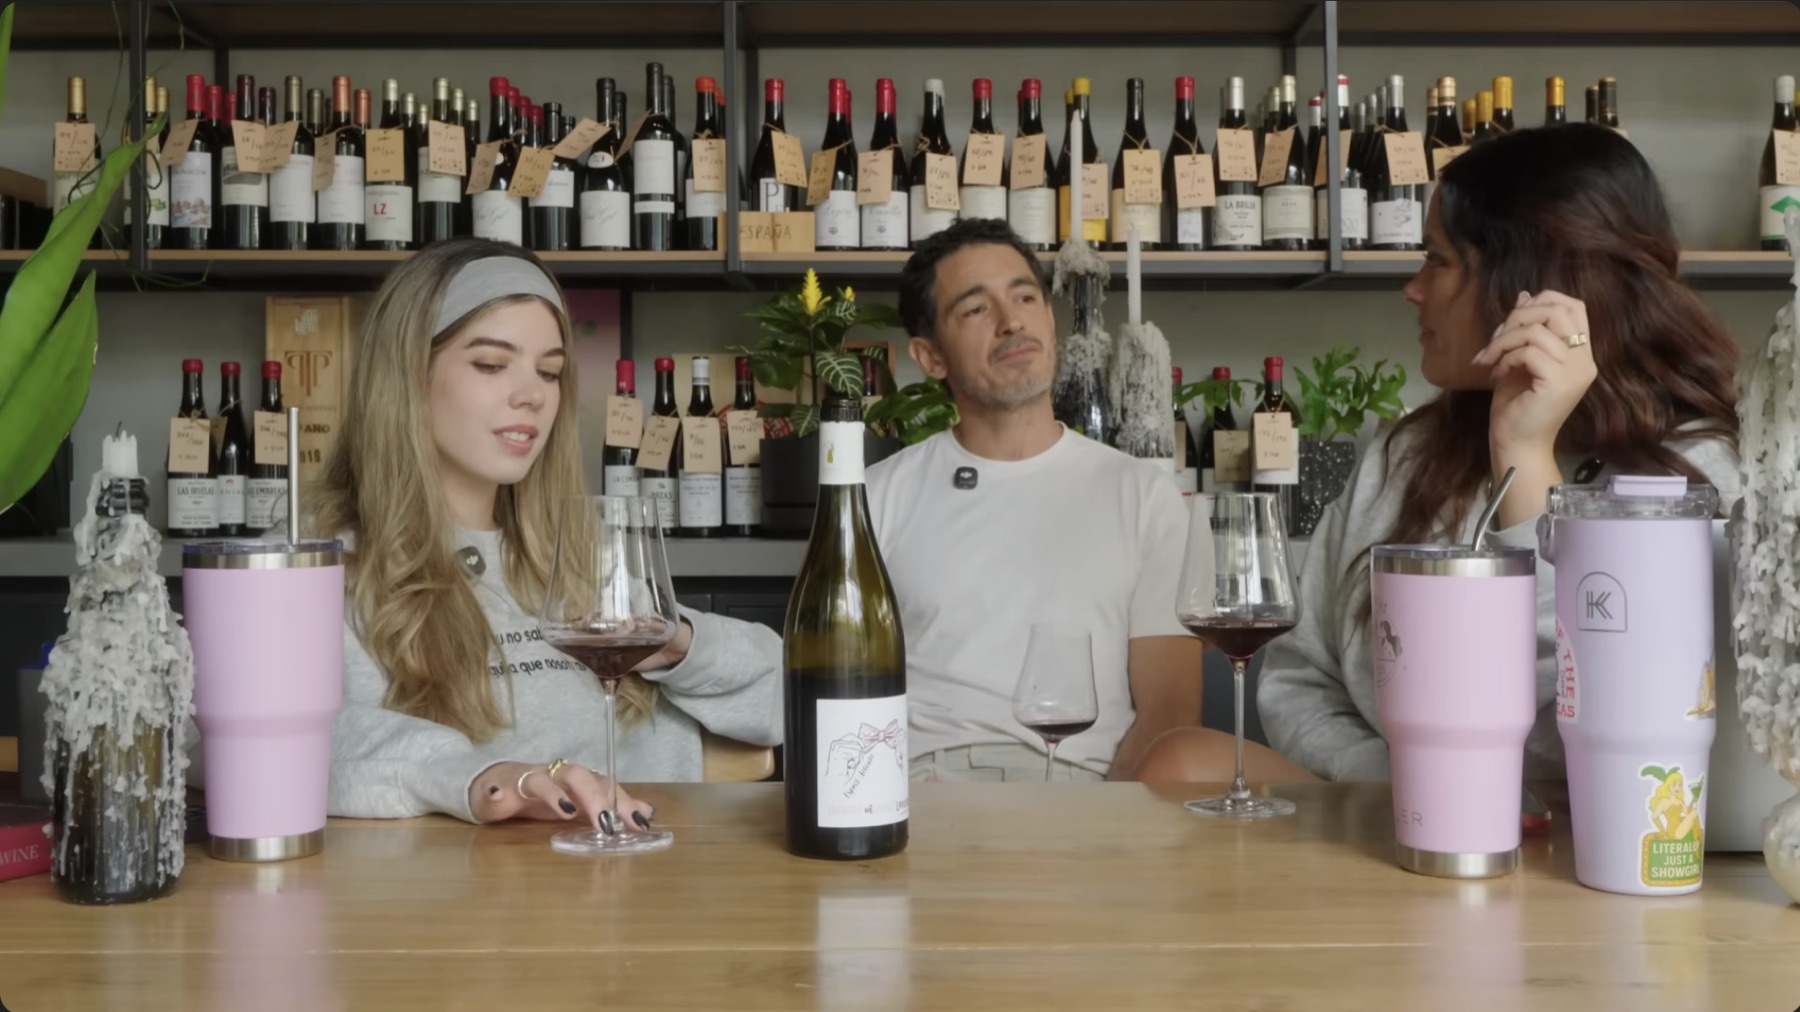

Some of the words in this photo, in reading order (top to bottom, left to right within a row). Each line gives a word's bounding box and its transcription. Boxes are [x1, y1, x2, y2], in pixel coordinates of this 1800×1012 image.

[373, 202, 388, 216] LZ
[739, 223, 792, 241] ESPAÑA
[506, 631, 522, 645] no
[524, 625, 545, 642] sab
[519, 659, 543, 676] que
[1397, 808, 1424, 827] ER
[0, 844, 40, 867] WINE
[1652, 841, 1700, 855] LITERALLY
[1663, 854, 1687, 866] JUST
[1687, 854, 1694, 864] A
[1651, 863, 1700, 879] SHOWGIRL
